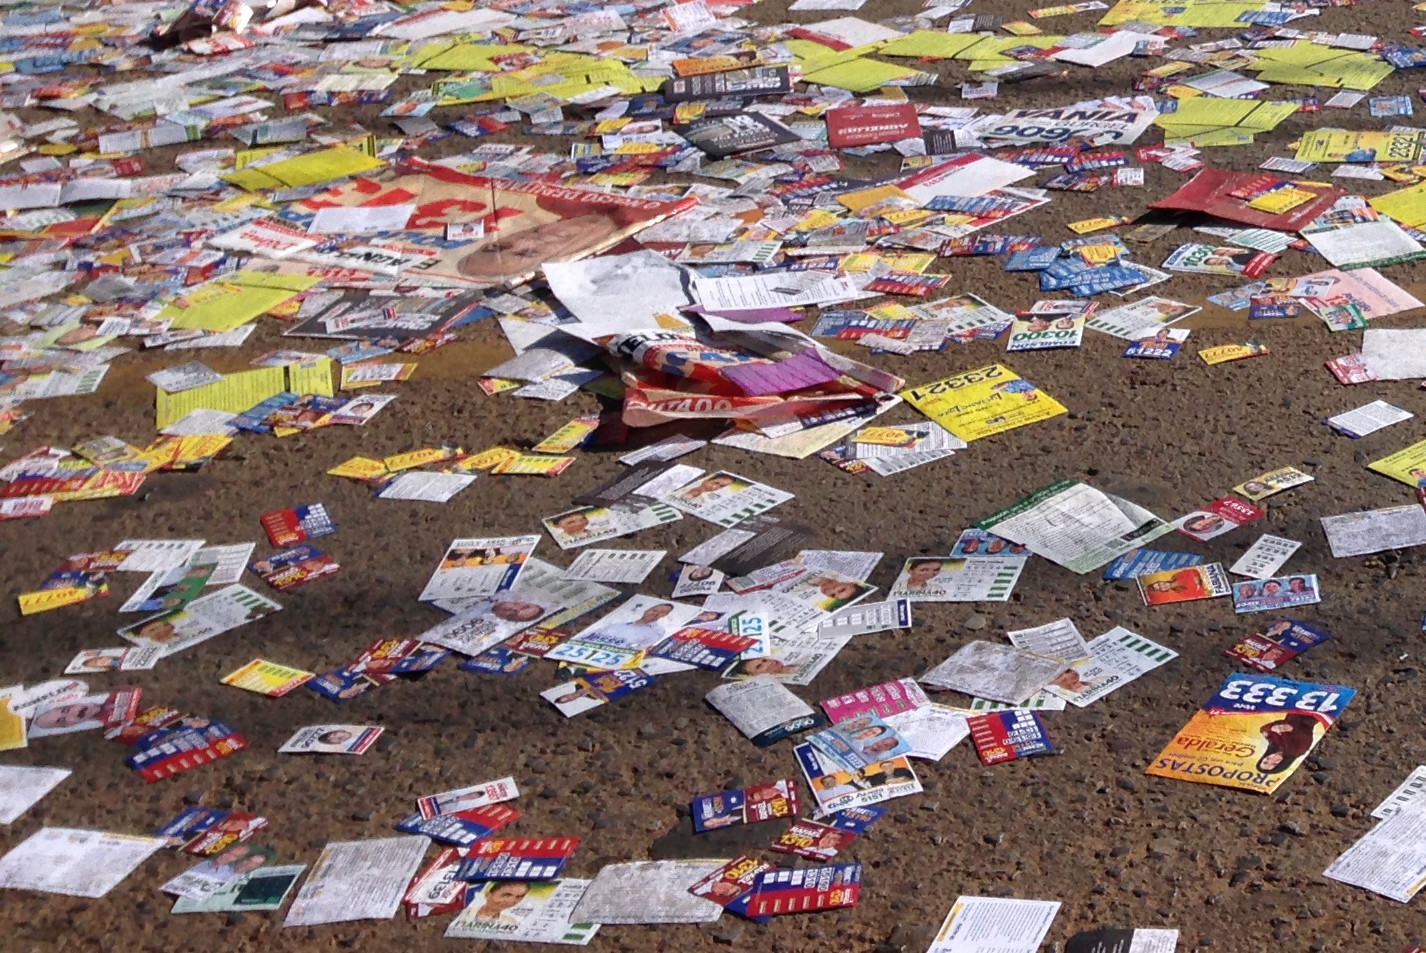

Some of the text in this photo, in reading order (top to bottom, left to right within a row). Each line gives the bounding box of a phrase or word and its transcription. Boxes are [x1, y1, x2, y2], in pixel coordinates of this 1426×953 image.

[1013, 330, 1078, 341] 10300
[1126, 347, 1172, 357] 51222
[910, 365, 1003, 401] 23321
[1219, 680, 1340, 712] 13 333
[1176, 736, 1256, 759] Geralda
[1155, 758, 1281, 788] PROPOSTAS
[780, 834, 814, 848] 1310
[790, 826, 821, 838] RAFAEL
